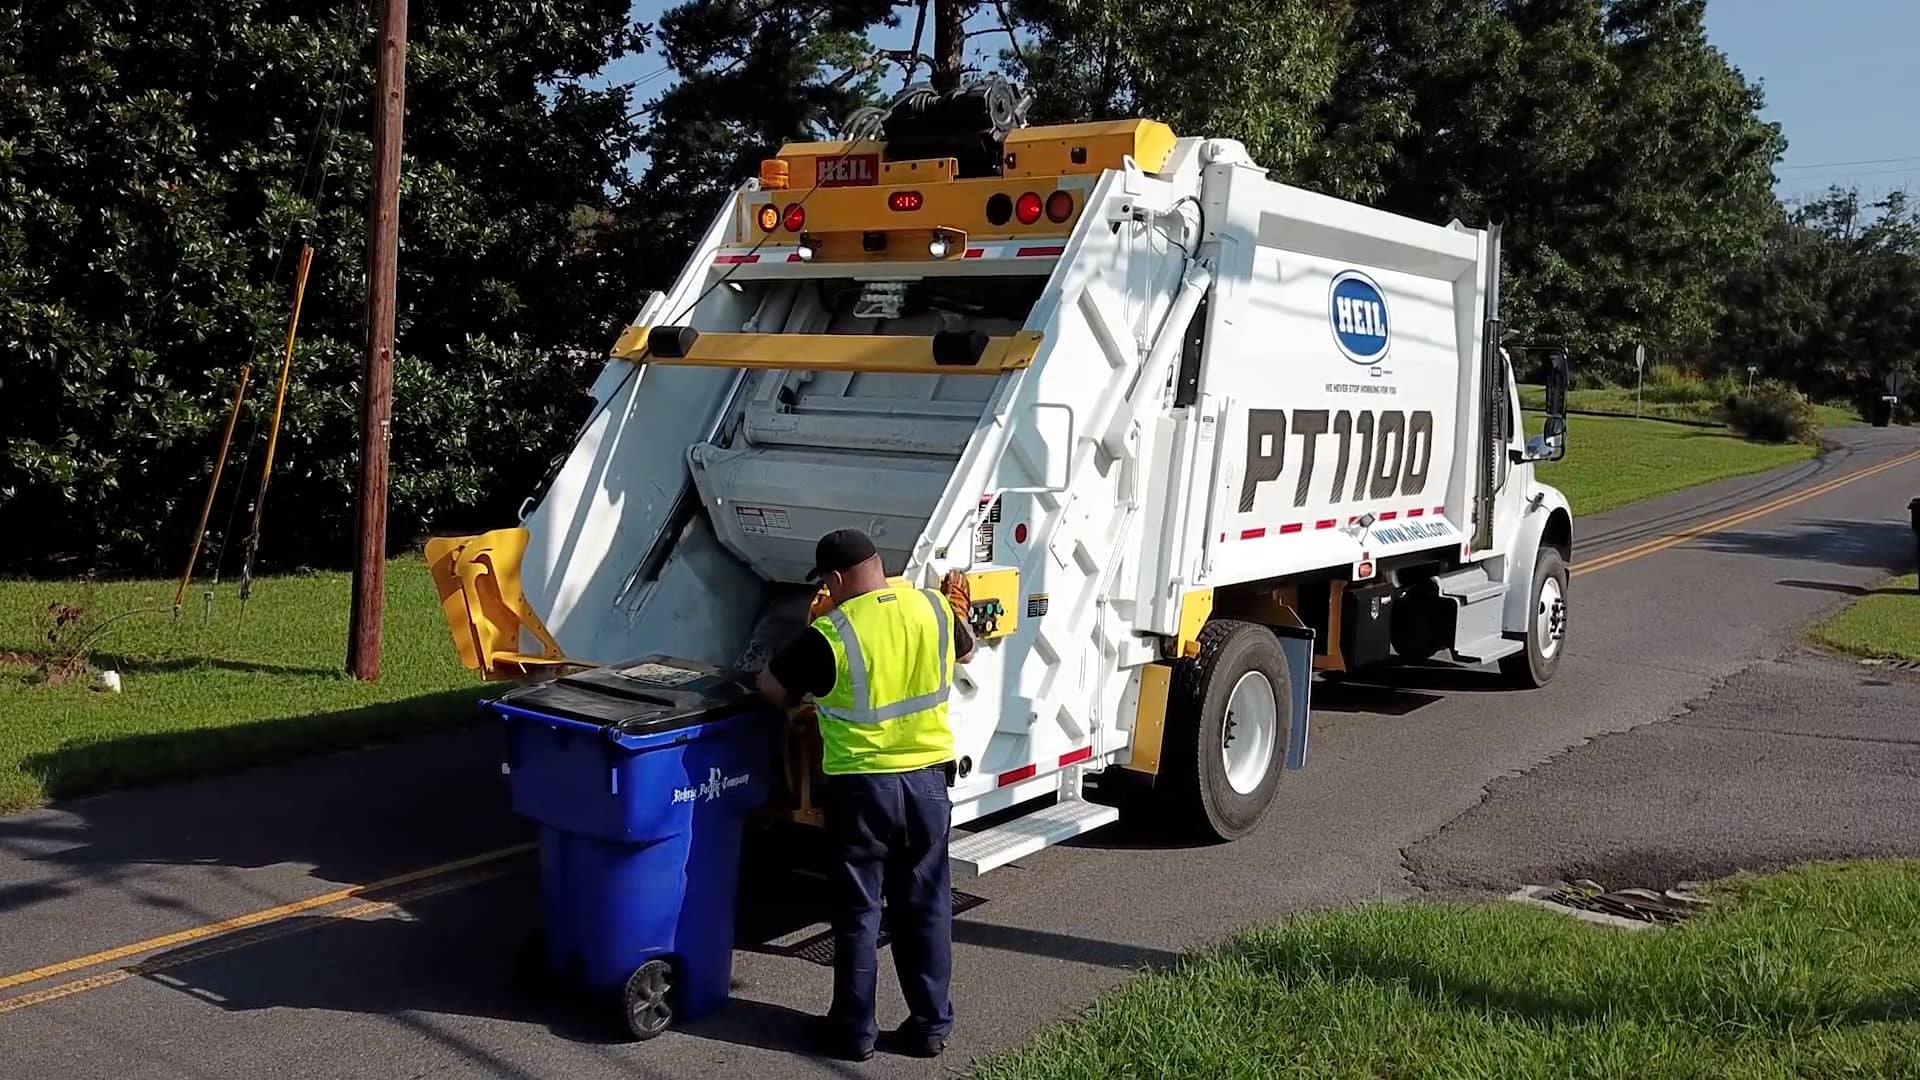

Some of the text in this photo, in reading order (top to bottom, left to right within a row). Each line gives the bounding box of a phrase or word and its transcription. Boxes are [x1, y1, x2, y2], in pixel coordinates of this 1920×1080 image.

[818, 159, 872, 181] HEIL
[1337, 296, 1386, 336] HEIL
[1333, 384, 1348, 393] NEVER
[1349, 384, 1360, 393] STOP
[1238, 408, 1433, 514] PT1100
[1371, 520, 1453, 545] www.heil.com
